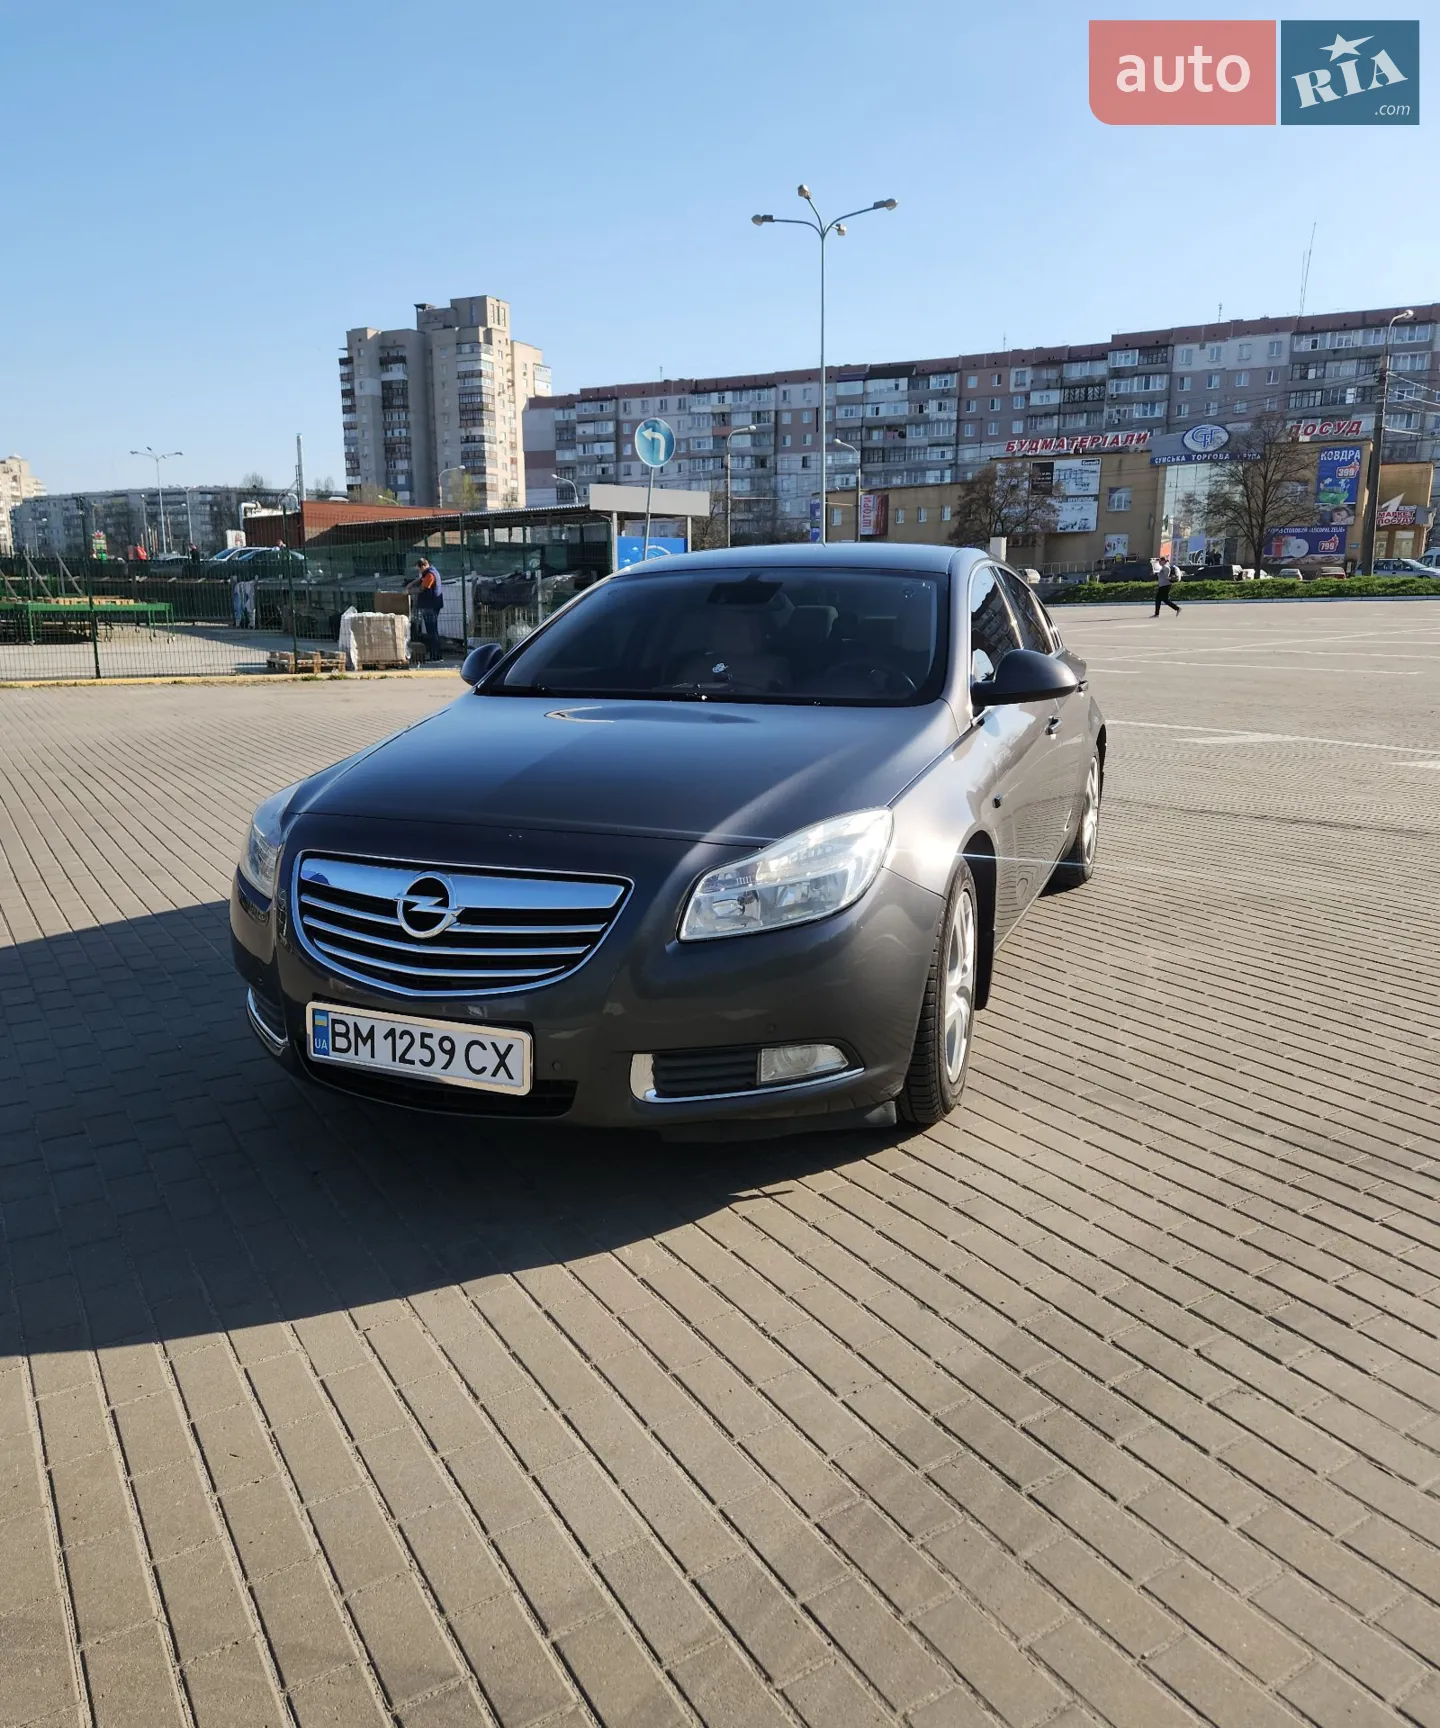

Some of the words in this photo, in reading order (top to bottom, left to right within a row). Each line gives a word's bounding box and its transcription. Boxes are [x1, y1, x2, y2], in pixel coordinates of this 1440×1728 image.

[1289, 420, 1362, 438] ПОСУД
[1005, 431, 1150, 454] БУДМАТЕРІАЛИ
[1191, 453, 1230, 461] ТОРГОВА
[1320, 449, 1361, 461] КОВДРА
[1338, 468, 1355, 477] 399
[315, 1038, 328, 1050] UA
[331, 1018, 375, 1059] BM
[383, 1027, 456, 1070] 1259
[464, 1039, 515, 1080] CX
